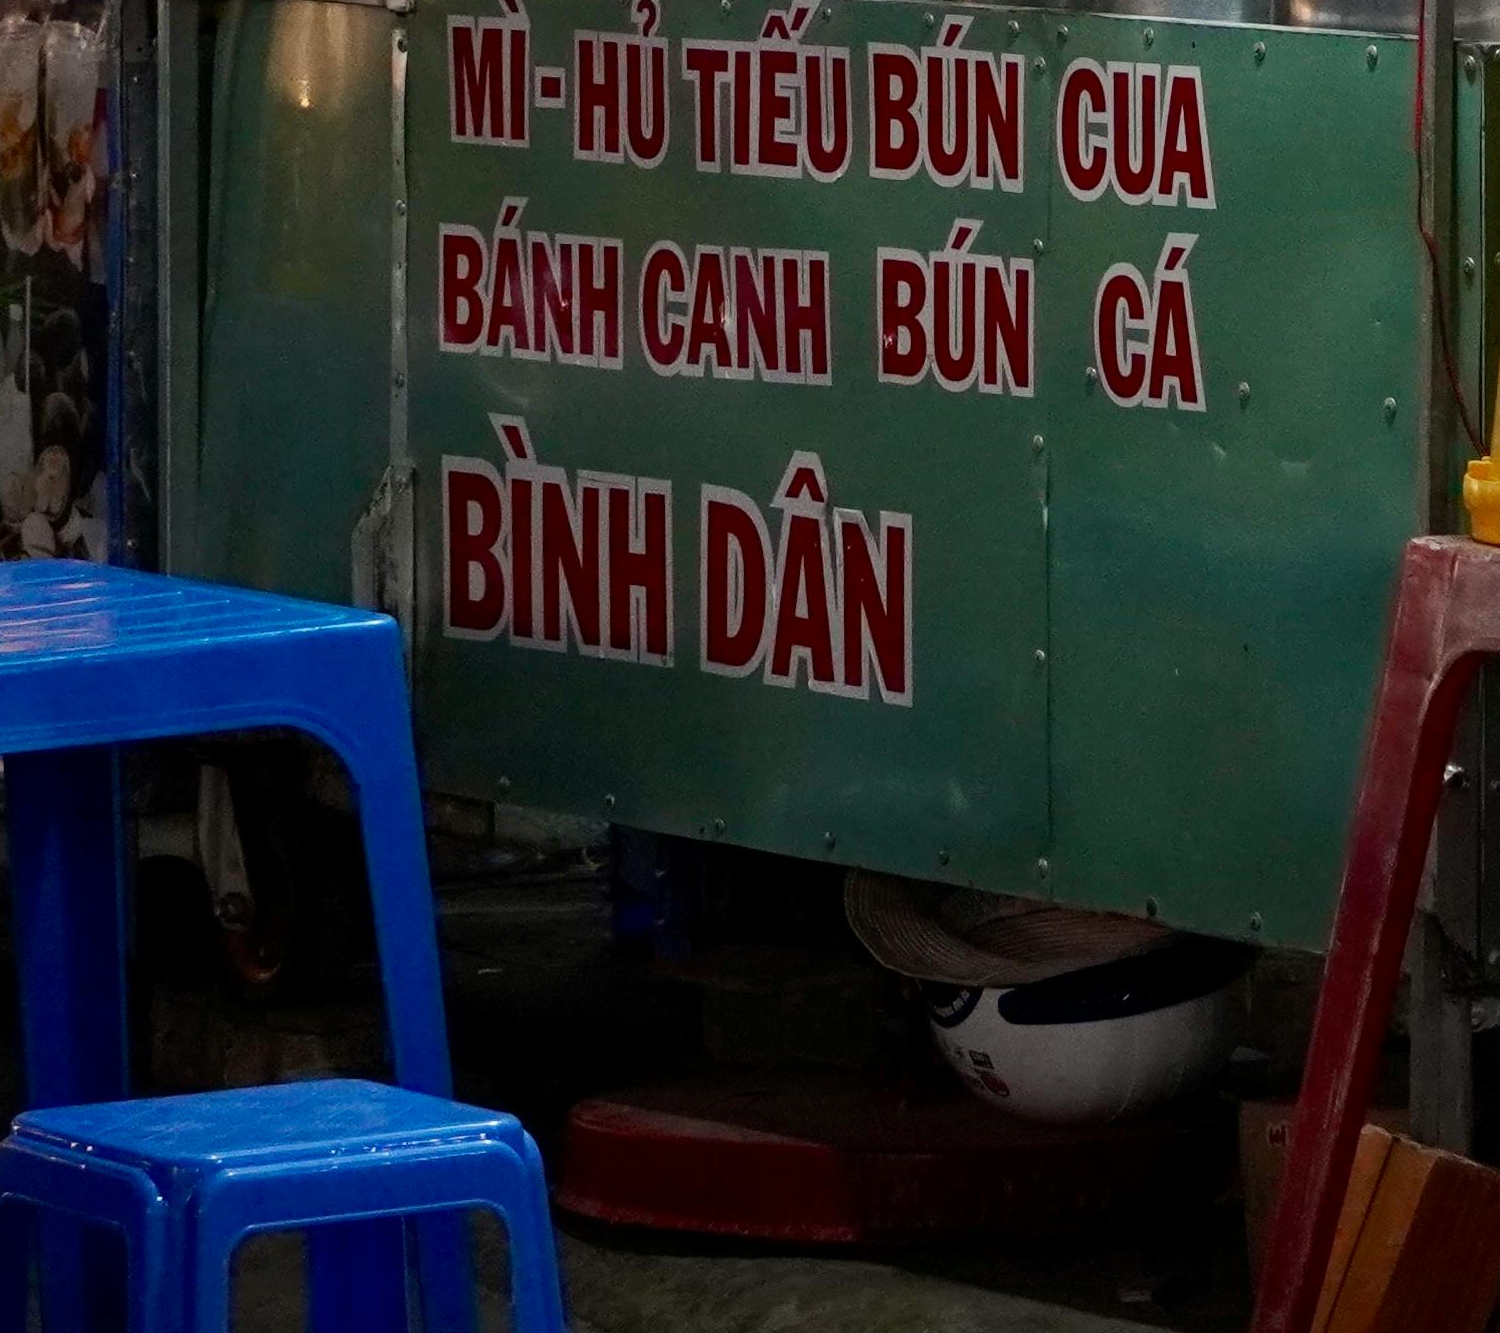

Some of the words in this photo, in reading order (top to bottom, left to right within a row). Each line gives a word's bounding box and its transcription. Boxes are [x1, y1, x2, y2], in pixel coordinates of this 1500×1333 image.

[869, 16, 1025, 193] BÚN
[1056, 57, 1215, 209] CUA
[439, 199, 623, 369] BÁNH
[639, 241, 831, 385] CANH
[876, 220, 1035, 397] BÚN
[1095, 233, 1208, 412] CÁ
[441, 413, 675, 667] BÌNH
[700, 449, 914, 708] DÂN
